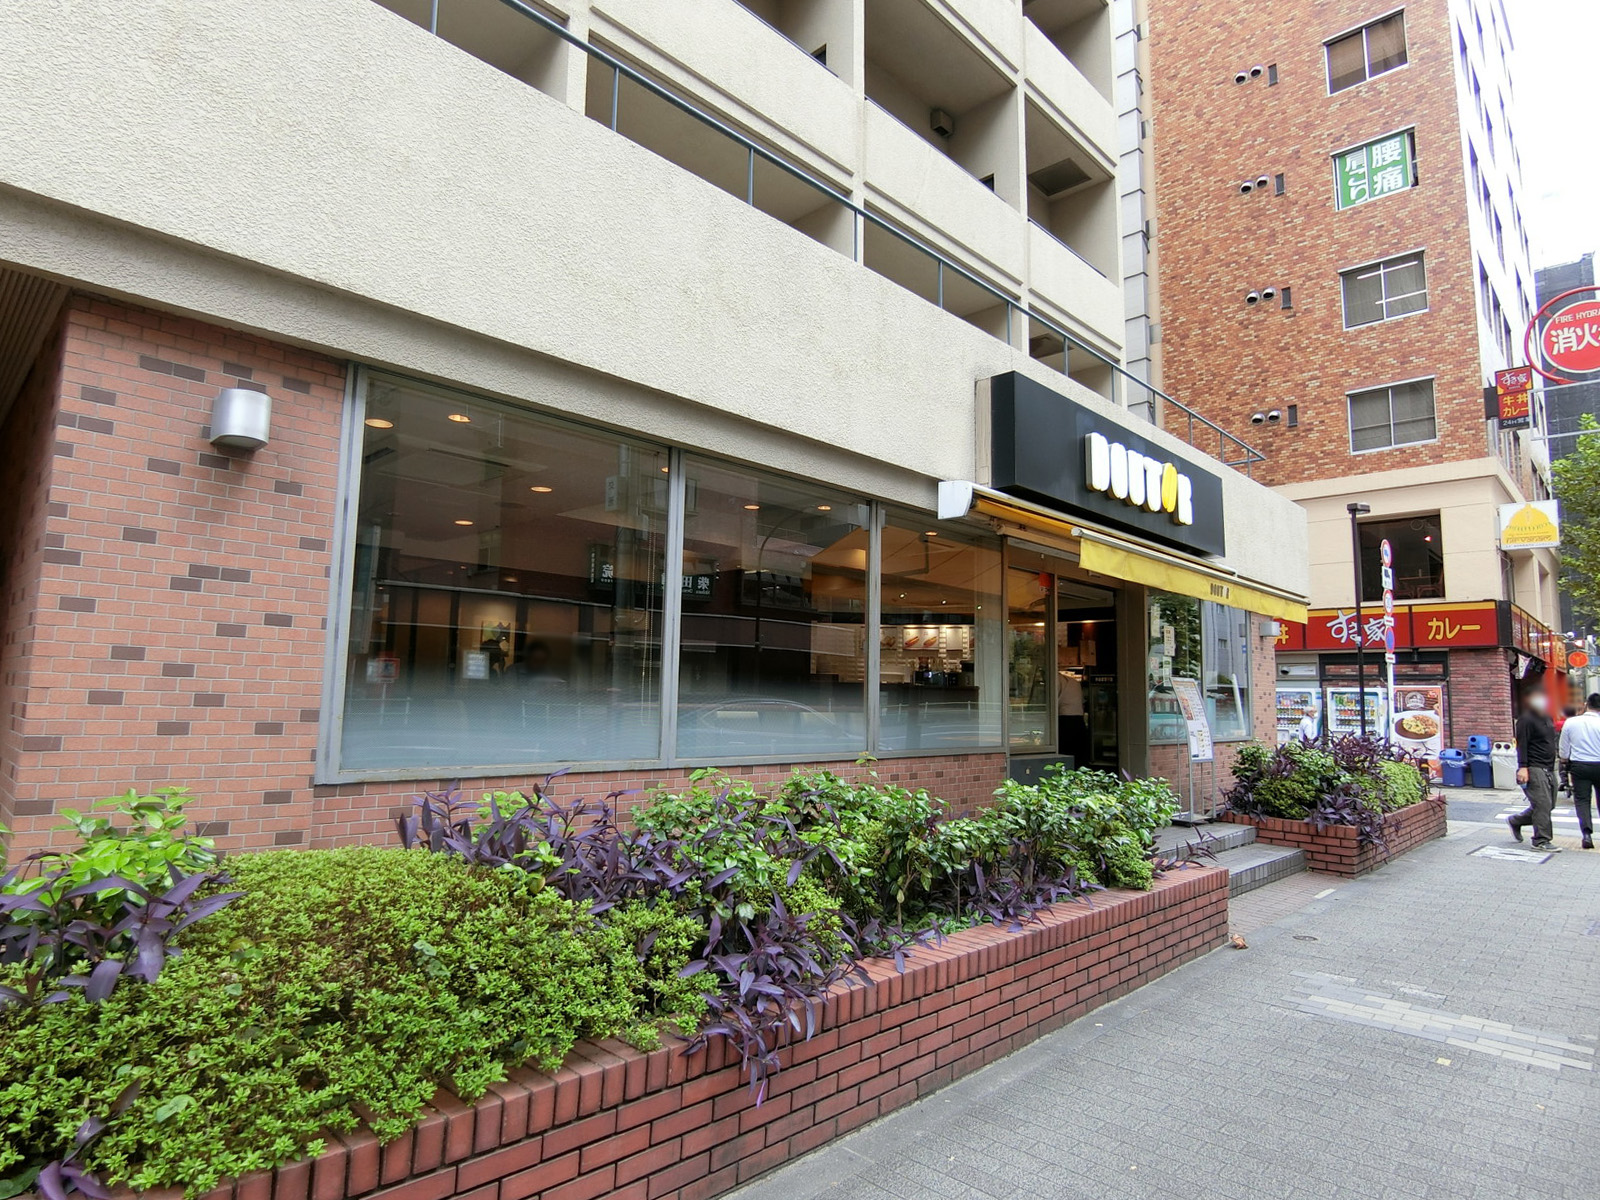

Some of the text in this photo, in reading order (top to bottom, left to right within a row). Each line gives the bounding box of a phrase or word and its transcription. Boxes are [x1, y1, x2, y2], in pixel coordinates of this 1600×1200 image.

[1371, 137, 1403, 195] 腰痛
[1555, 314, 1574, 325] FIRE
[1550, 323, 1600, 355] 消火
[1503, 392, 1528, 406] 牛丼
[1503, 405, 1529, 418] カレー
[1326, 609, 1386, 647] すき家
[1428, 617, 1481, 641] カレー
